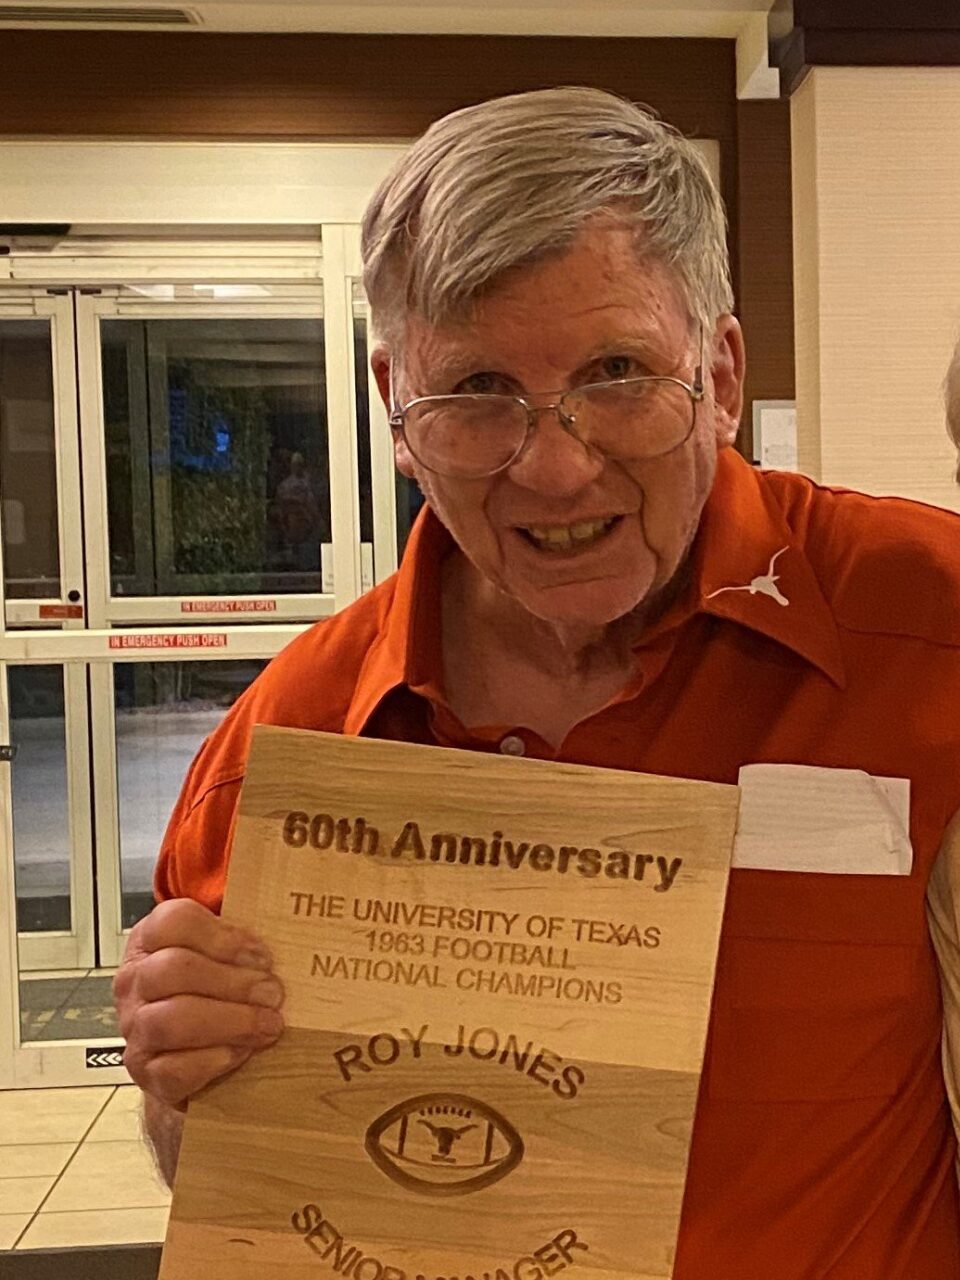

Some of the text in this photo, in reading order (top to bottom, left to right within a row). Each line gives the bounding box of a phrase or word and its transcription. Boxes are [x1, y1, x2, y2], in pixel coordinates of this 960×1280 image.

[192, 602, 234, 612] EMERGENCY
[236, 601, 255, 611] PUSH
[257, 600, 275, 611] OPEN
[111, 634, 225, 647] IN EMERGENCY PUSH OPEN
[283, 811, 683, 892] 60th Anniversary
[290, 892, 661, 948] THE UNIVERSITY OF TEXAS
[366, 930, 576, 970] 1963 FOOTBALL
[311, 954, 623, 1004] NATIONAL CHAMPIONS
[334, 1024, 585, 1100] ROY JONES
